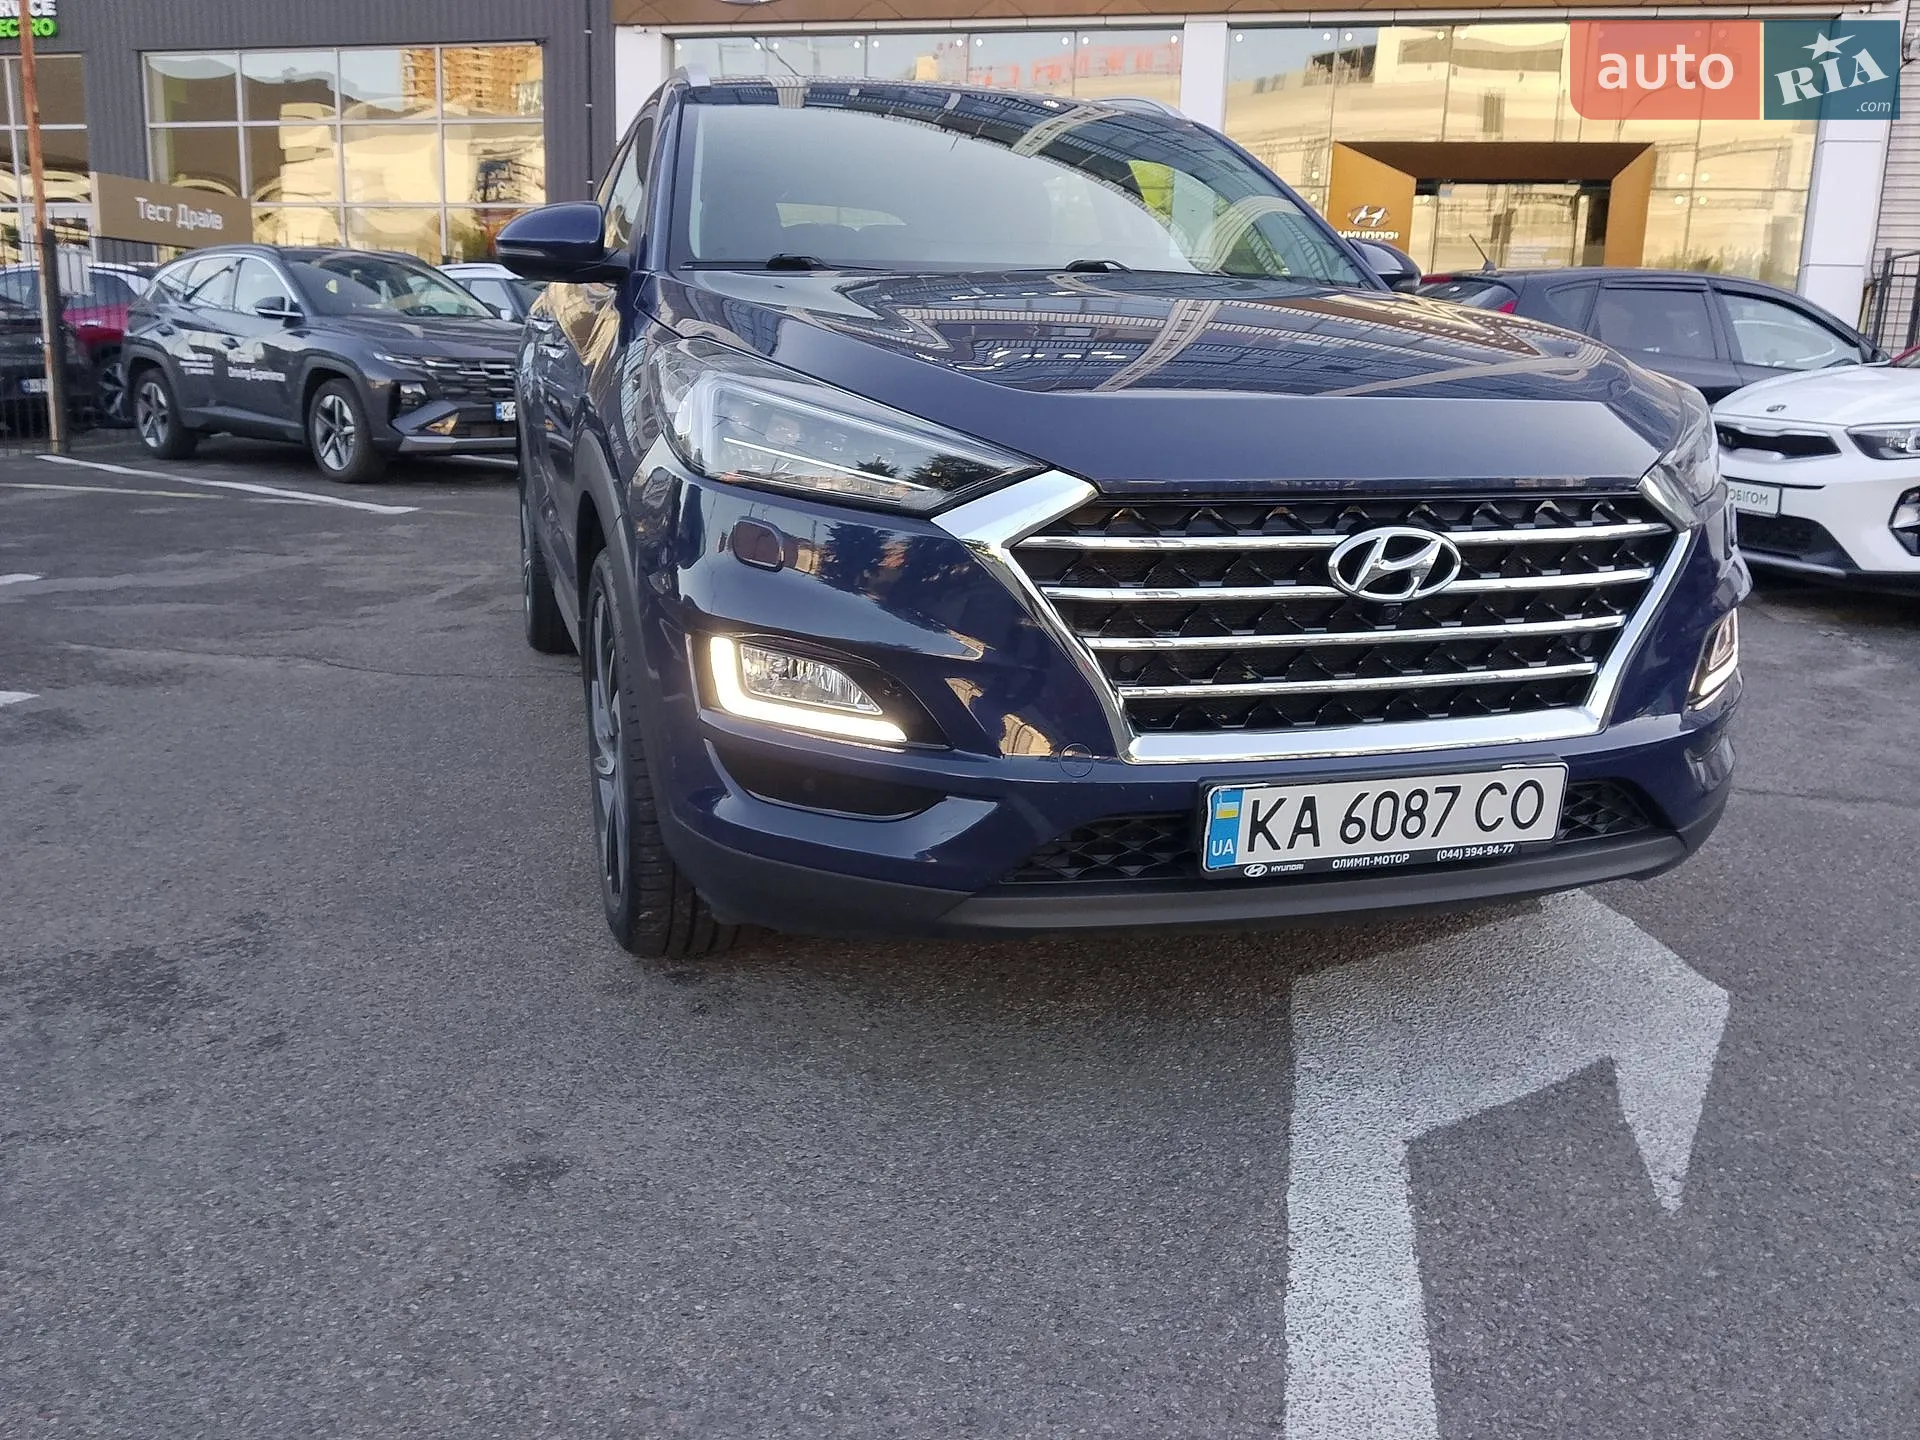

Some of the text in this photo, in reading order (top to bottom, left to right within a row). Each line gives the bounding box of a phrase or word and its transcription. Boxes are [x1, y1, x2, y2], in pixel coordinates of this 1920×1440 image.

[0, 0, 56, 17] RVCE
[0, 18, 55, 37] ECRO
[134, 196, 224, 231] Тест Драйв
[1247, 779, 1545, 852] KA 6087 CO
[1211, 838, 1235, 856] UA
[1436, 843, 1515, 862] (044) 394-94-77
[1270, 863, 1305, 873] HYUNDAI
[1332, 853, 1410, 869] ОЛИМП-МОТОР
